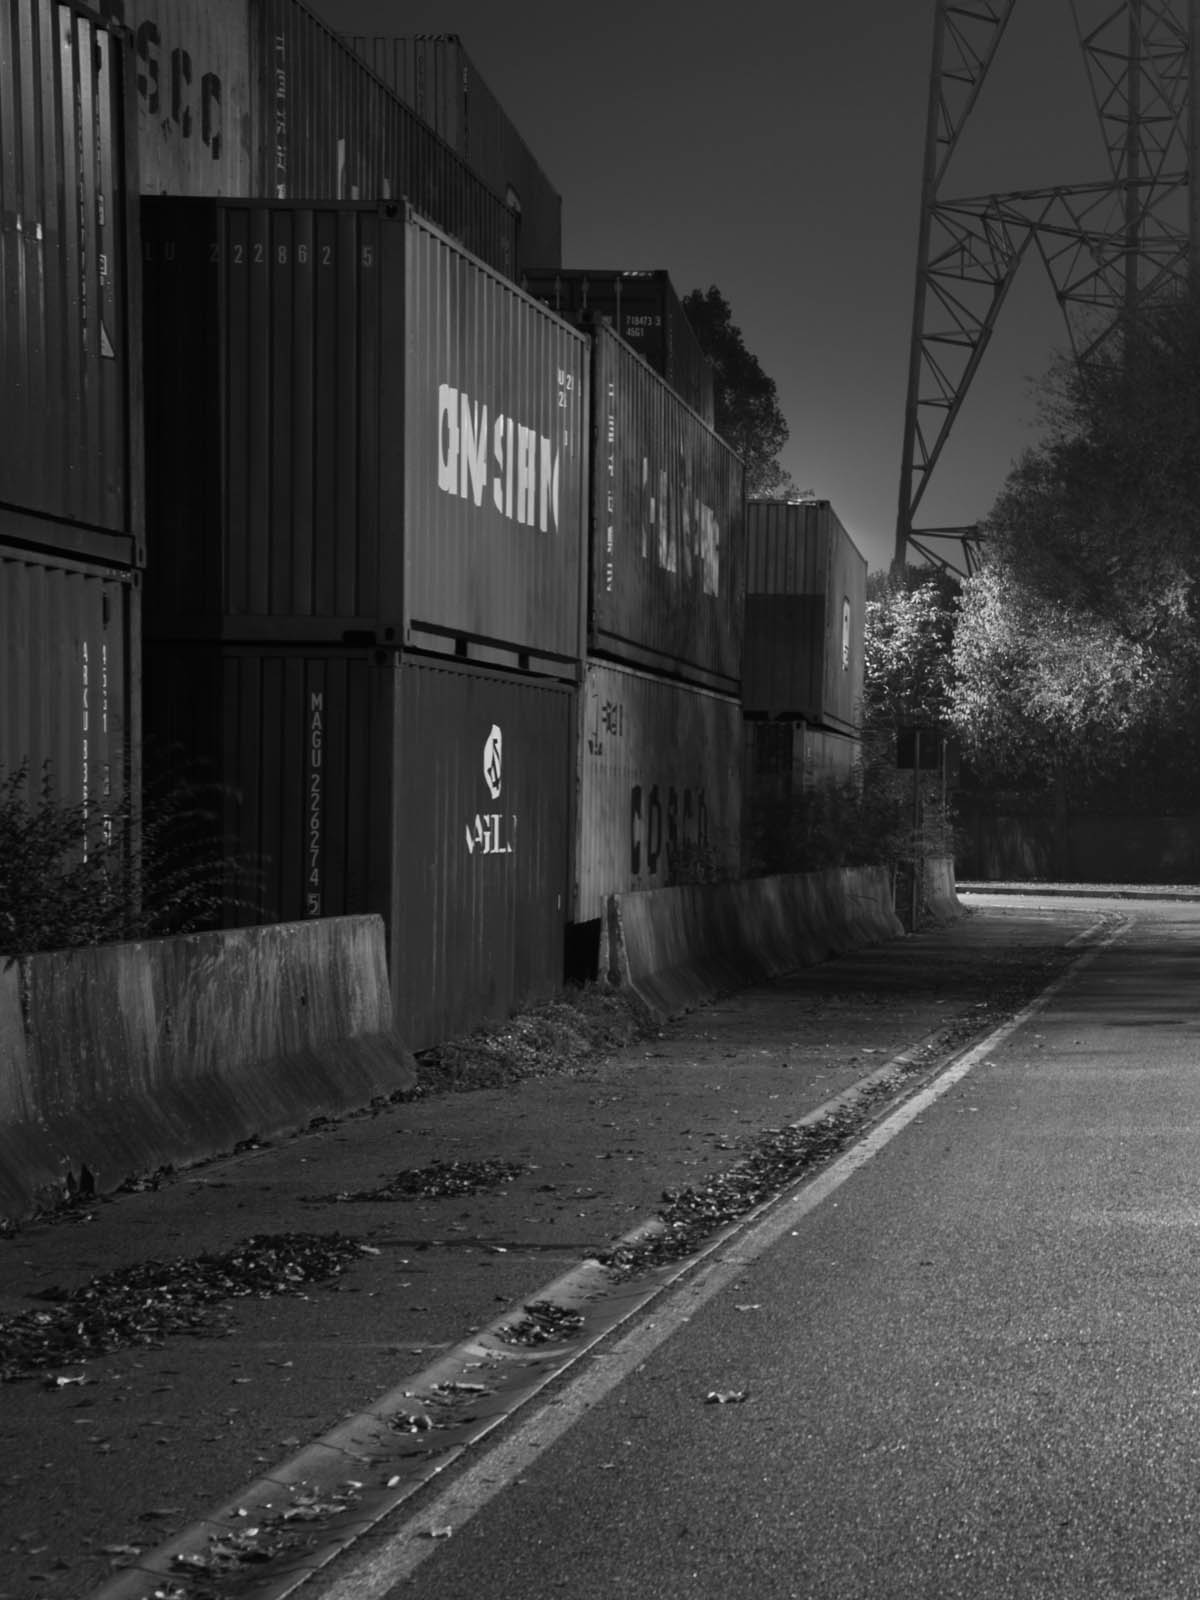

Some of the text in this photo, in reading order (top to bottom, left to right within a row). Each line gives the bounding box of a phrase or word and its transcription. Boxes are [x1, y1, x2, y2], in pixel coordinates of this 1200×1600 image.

[207, 242, 332, 265] 222862
[360, 245, 374, 267] 5
[306, 692, 324, 915] MAGU 226274 5
